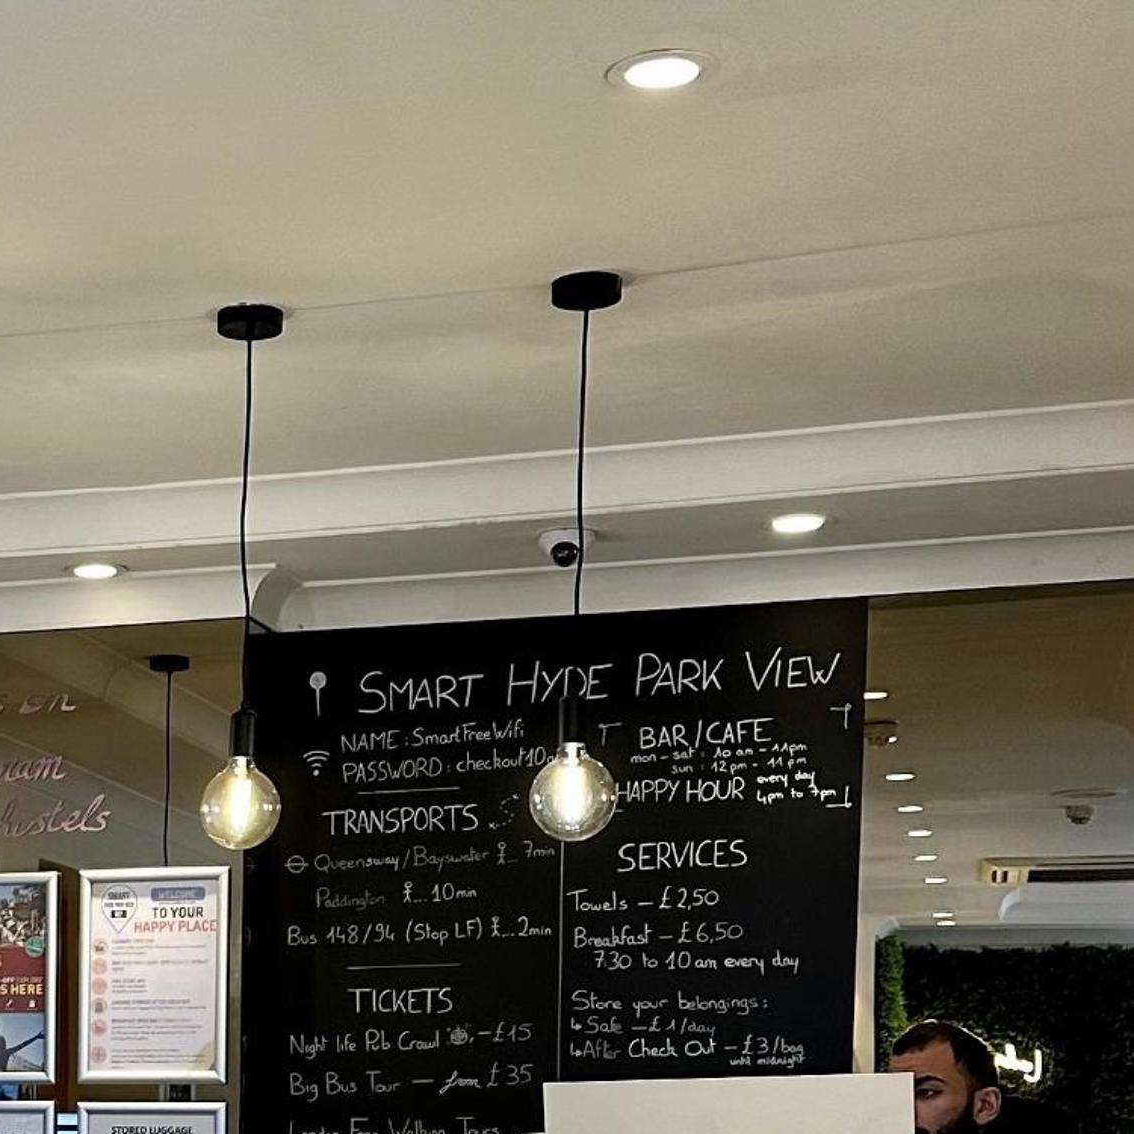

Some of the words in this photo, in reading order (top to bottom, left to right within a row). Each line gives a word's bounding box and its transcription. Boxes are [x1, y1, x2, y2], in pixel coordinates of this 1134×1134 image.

[357, 670, 484, 714] SMART
[507, 660, 613, 706] HYDE
[635, 652, 724, 696] PARK
[745, 647, 841, 691] VIEW
[617, 778, 680, 803] HAPPY
[686, 776, 745, 803] HOUR
[322, 804, 479, 835] TRANSPORTS
[617, 839, 748, 872] SERVICES
[316, 886, 385, 911] Paddington
[566, 888, 628, 912] Towels
[152, 907, 167, 918] TO
[170, 906, 204, 918] YOUR
[134, 921, 175, 932] HAPPY
[178, 920, 217, 932] PLACE
[287, 925, 317, 946] Bus
[573, 923, 653, 948] Breakfast
[642, 951, 658, 968] to
[724, 957, 765, 976] every
[771, 950, 799, 975] day
[10, 983, 43, 995] HERE
[346, 987, 453, 1015] TICKETS
[571, 989, 623, 1011] Store
[632, 999, 669, 1018] your
[289, 1033, 330, 1060] Night
[336, 1033, 357, 1053] life
[365, 1028, 391, 1051] Pub
[397, 1028, 440, 1051] Crawl
[628, 1037, 678, 1058] Check
[684, 1038, 717, 1057] Out
[289, 1072, 318, 1103] Big
[325, 1071, 357, 1095] Bus
[365, 1070, 401, 1093] Tour
[111, 1126, 147, 1134] STORED
[149, 1126, 193, 1134] LUGGAGE
